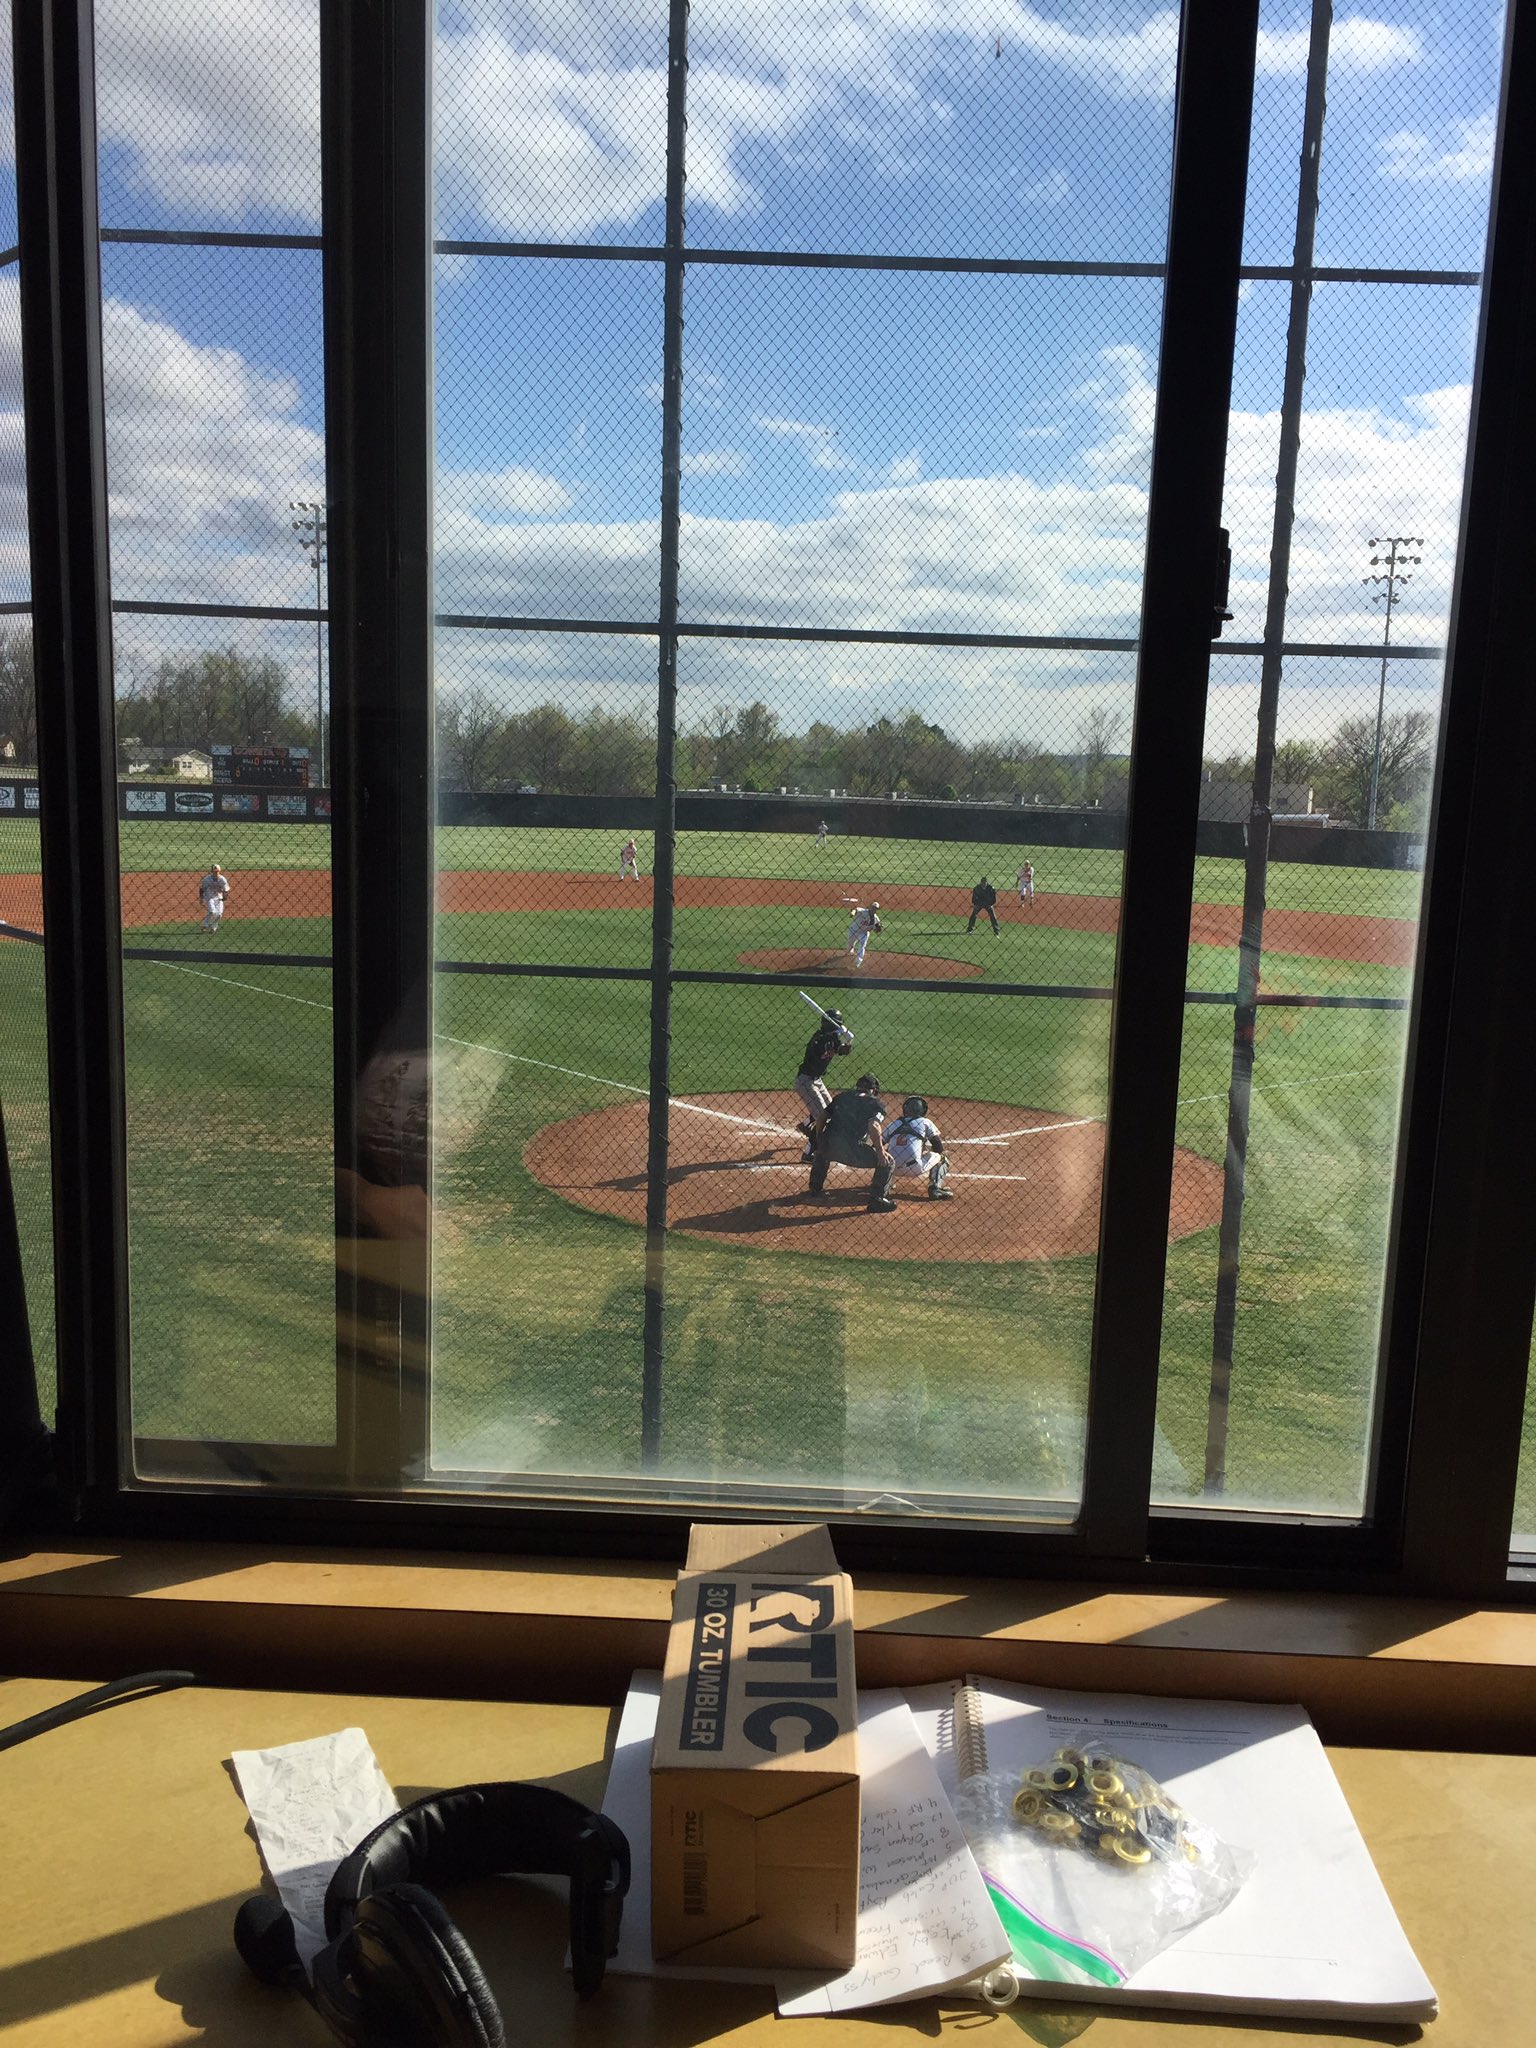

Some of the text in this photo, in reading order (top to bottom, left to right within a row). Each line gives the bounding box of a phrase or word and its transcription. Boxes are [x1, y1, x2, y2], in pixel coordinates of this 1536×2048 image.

[690, 1588, 729, 1745] 30 OZ. TUMBLER
[743, 1583, 839, 1753] RTIC
[1047, 1714, 1081, 1723] Section
[1103, 1718, 1168, 1729] Specifications
